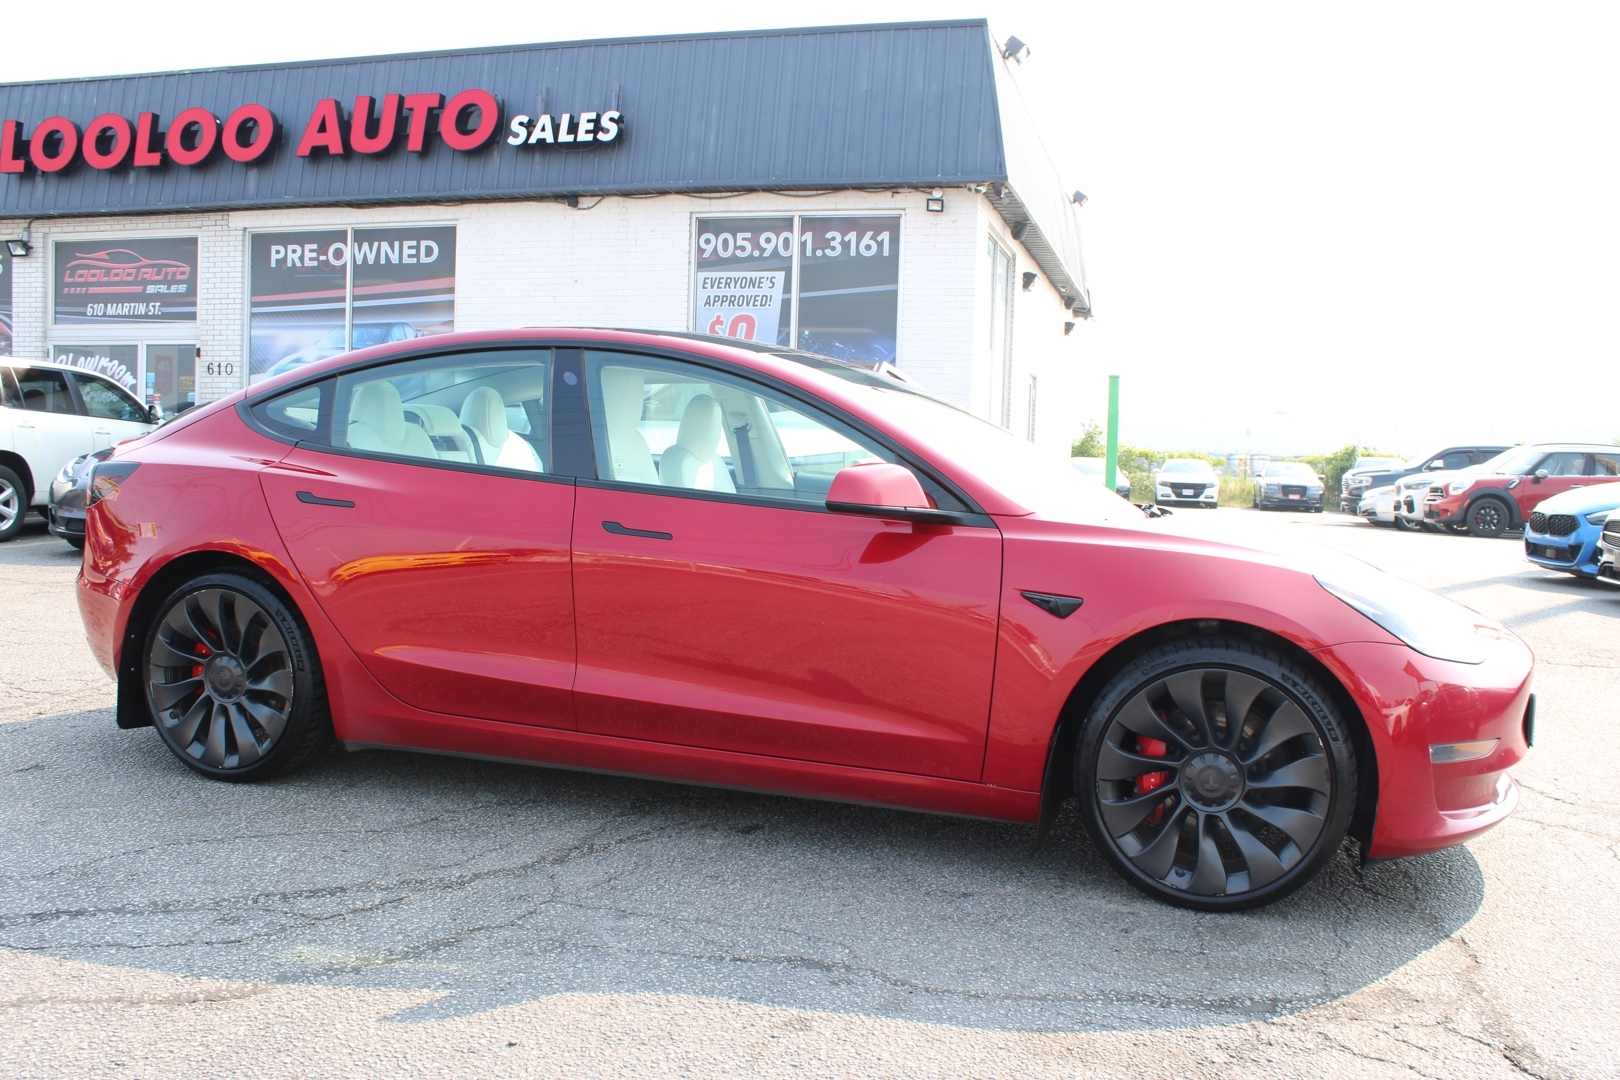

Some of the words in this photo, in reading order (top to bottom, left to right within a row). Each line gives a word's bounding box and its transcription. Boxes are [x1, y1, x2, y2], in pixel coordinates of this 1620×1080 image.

[0, 103, 275, 174] LOOLOO
[295, 88, 499, 158] AUTO
[507, 109, 620, 146] SALES
[698, 230, 890, 258] 905.901.3161
[269, 239, 440, 268] PRE-OWNED
[63, 268, 137, 283] LOOLOO
[138, 267, 191, 281] AUTO
[701, 275, 776, 290] EVERYONE'S
[145, 284, 188, 294] SALES
[86, 303, 105, 316] 610
[106, 302, 146, 316] MARTIN
[148, 302, 162, 315] ST.
[703, 294, 773, 308] APPROVED!
[206, 362, 234, 376] 610
[281, 620, 305, 670] MICHELIN
[1294, 683, 1339, 742] MICHELIN
